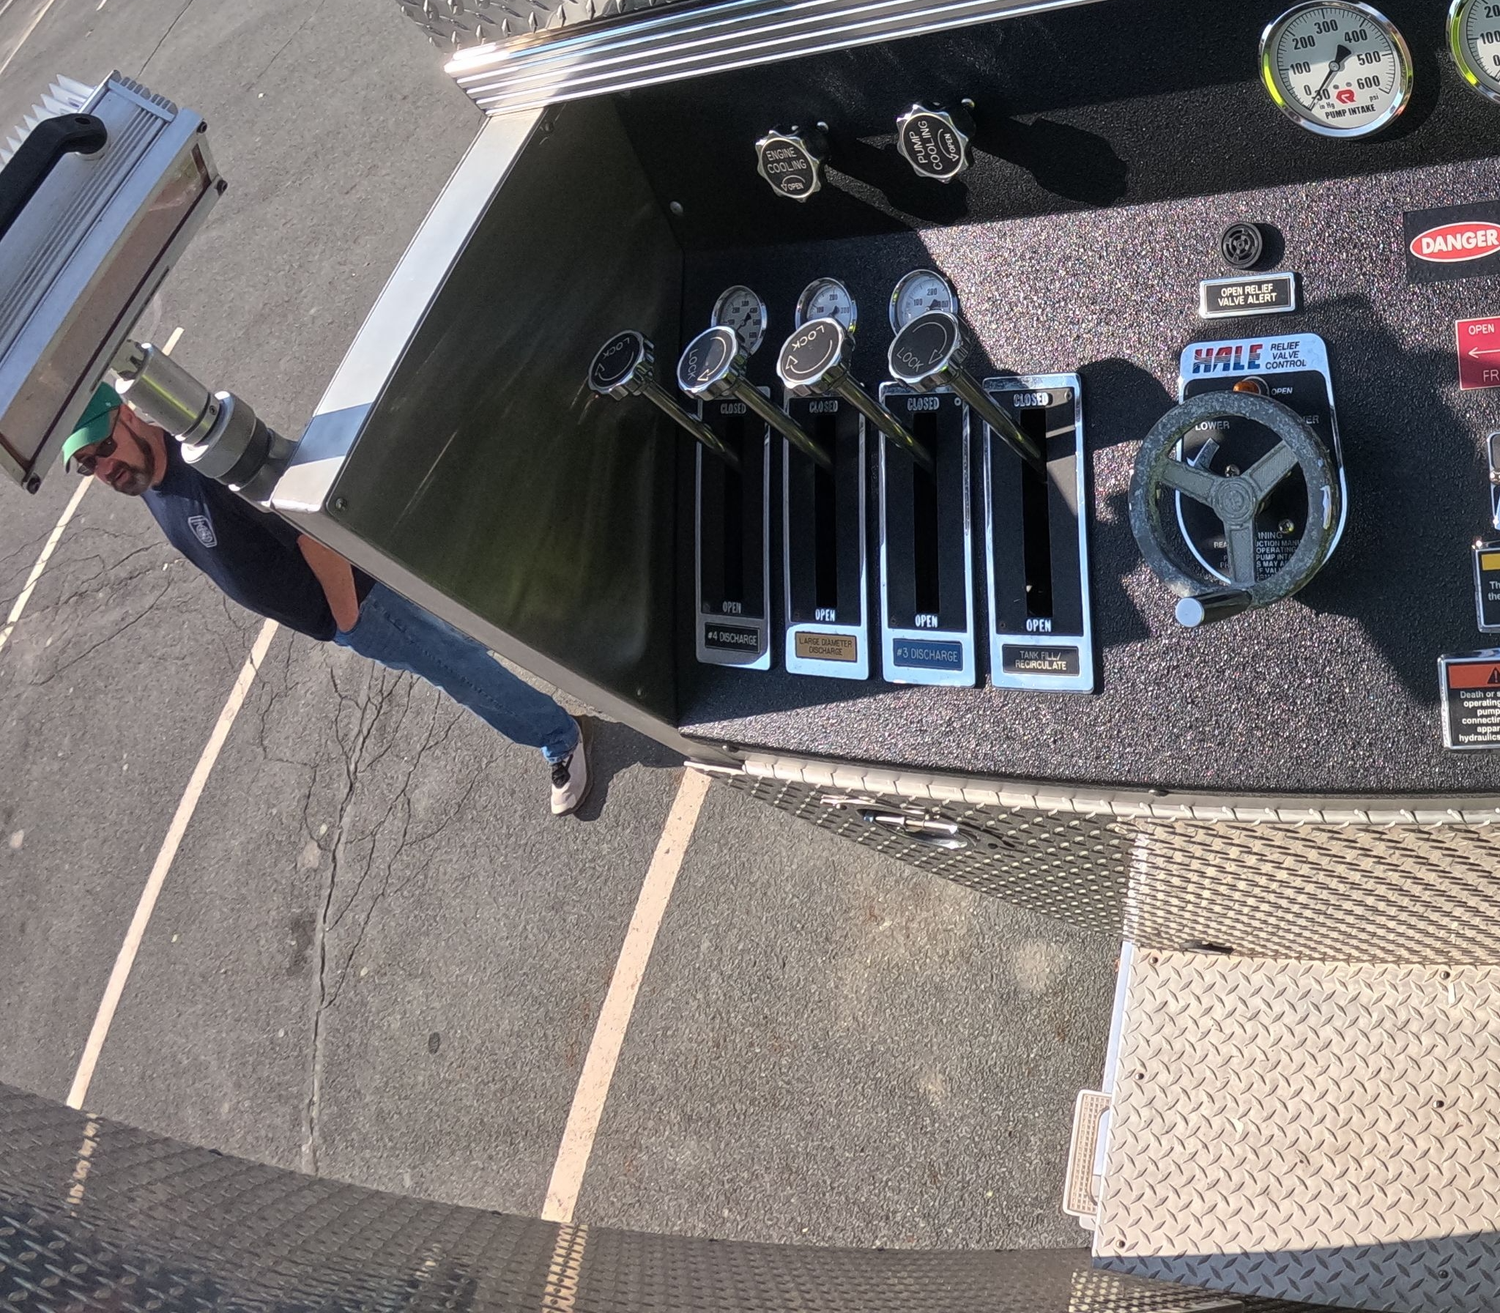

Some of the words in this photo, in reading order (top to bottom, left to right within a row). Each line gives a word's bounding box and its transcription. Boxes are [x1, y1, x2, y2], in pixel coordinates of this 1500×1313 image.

[1369, 93, 1379, 102] psi
[1325, 109, 1346, 119] PUMP
[1350, 104, 1376, 116] INTAKE
[908, 131, 928, 164] PUMP
[917, 120, 943, 171] COOLING
[766, 147, 797, 162] ENGINE
[767, 159, 807, 174] COOLING
[1421, 229, 1499, 255] DANGER
[1221, 287, 1243, 297] OPEN
[1245, 284, 1273, 294] RELIEF
[1218, 295, 1245, 307] VALVE
[1247, 293, 1277, 304] ALERT
[1468, 325, 1495, 335] OPEN
[1270, 341, 1300, 351] RELIEF
[1192, 344, 1263, 374] HALE
[1272, 351, 1299, 360] VALVE
[1265, 359, 1306, 370] CONTROL
[1195, 421, 1230, 431] LOWER
[707, 631, 718, 641] #4
[720, 633, 757, 646] DISCHARGE
[800, 637, 819, 646] LARGE
[822, 638, 852, 647] DIAMETER
[809, 646, 843, 655] DISCHARGE
[897, 646, 909, 658] #3
[910, 649, 958, 662] DISCHARGE
[1020, 651, 1038, 660] TANK
[1015, 659, 1067, 670] RECIRCULATE
[1460, 690, 1484, 699] Death
[1477, 708, 1500, 717] pump
